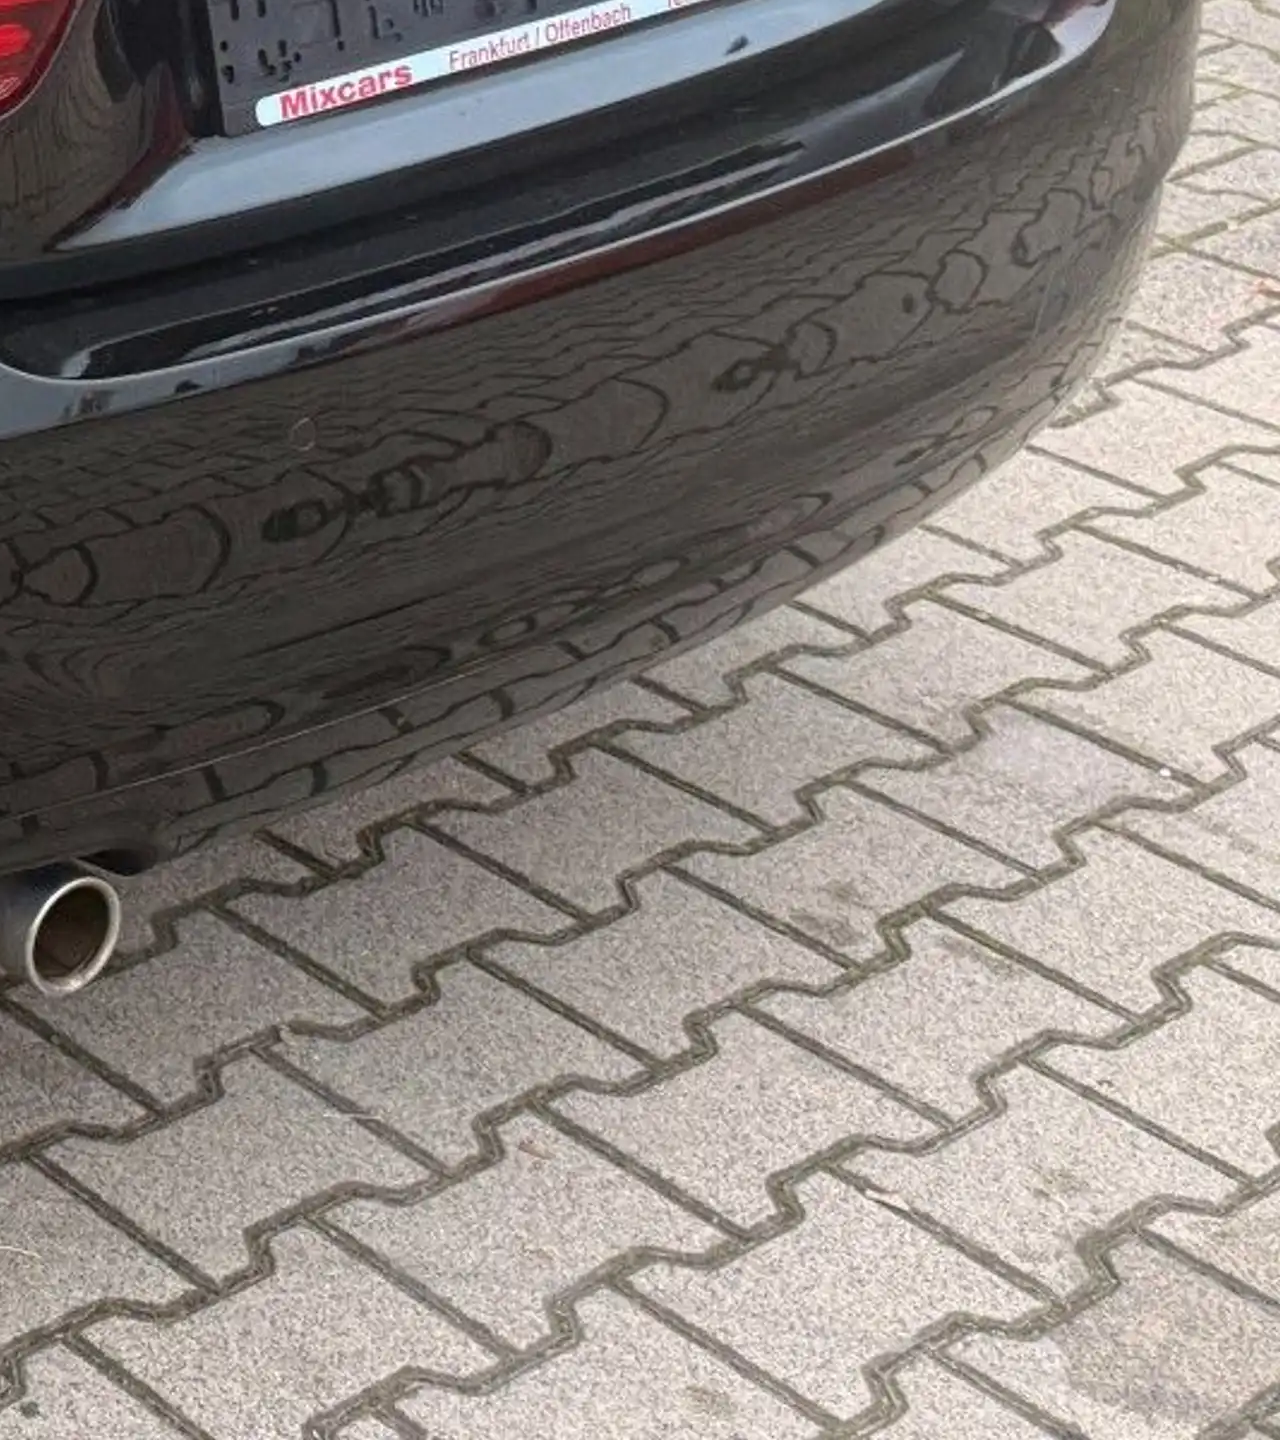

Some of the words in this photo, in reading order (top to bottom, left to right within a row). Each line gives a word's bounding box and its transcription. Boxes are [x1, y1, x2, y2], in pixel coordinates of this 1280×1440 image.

[278, 64, 414, 121] Mixcars
[447, 30, 531, 72] Frankfurt
[544, 2, 632, 44] Offenbach
